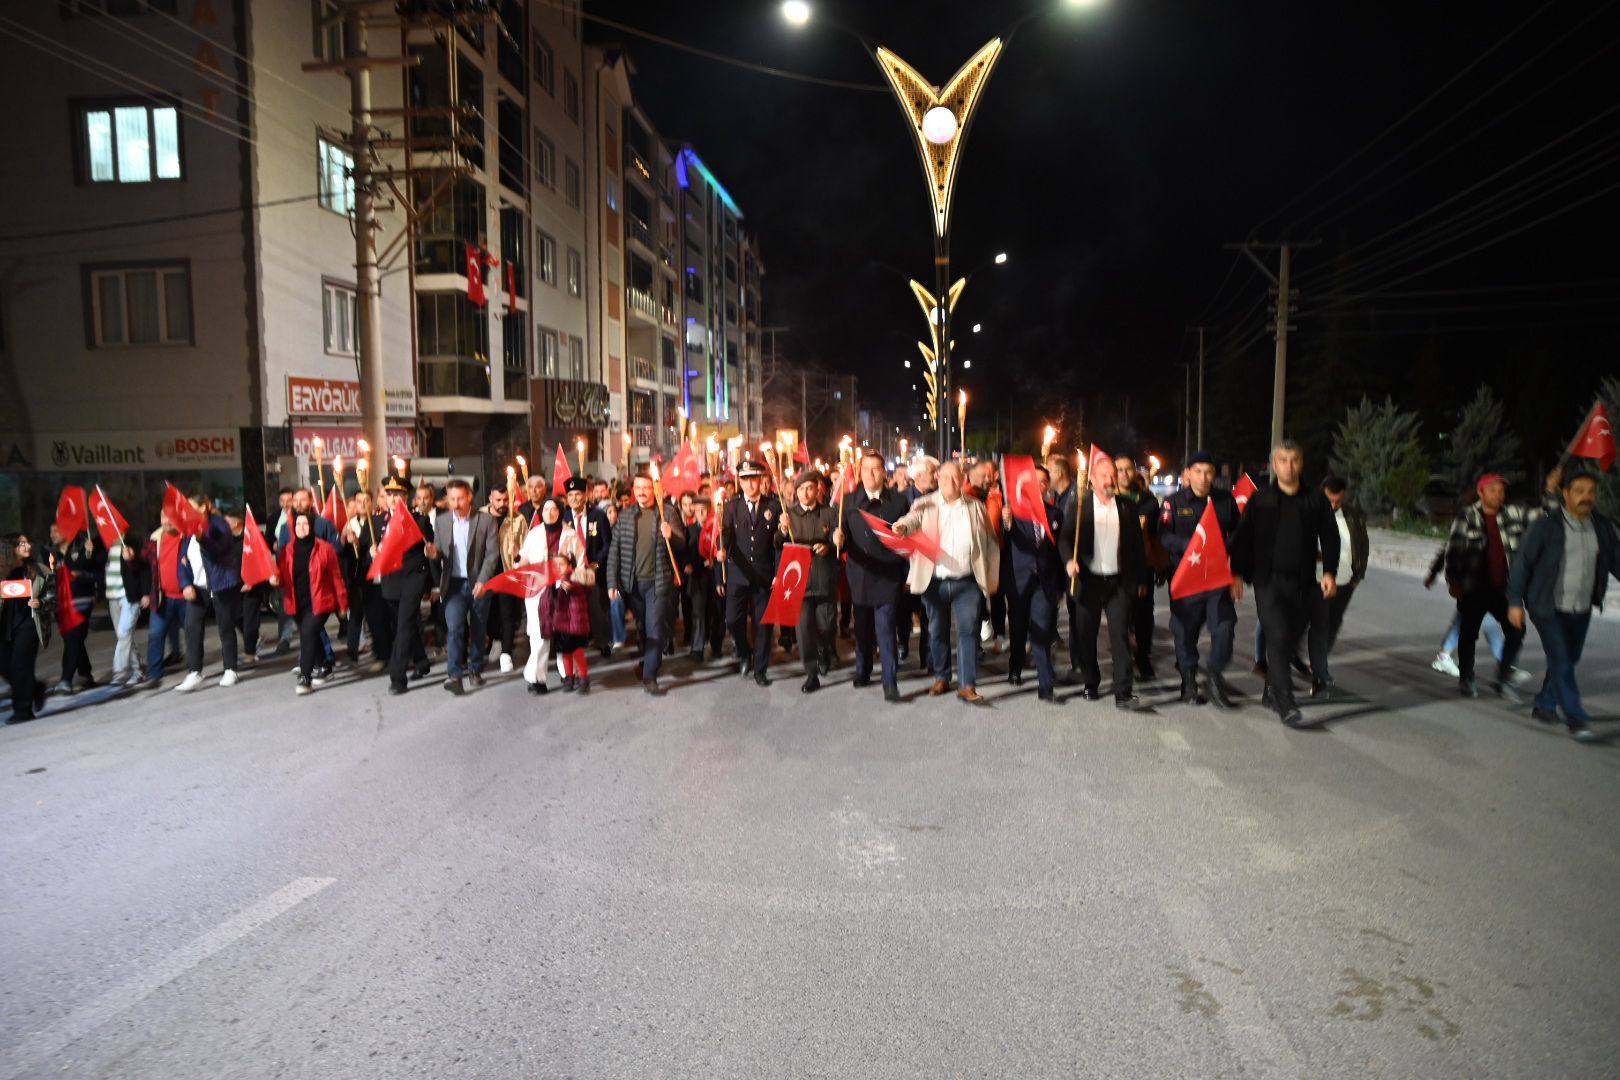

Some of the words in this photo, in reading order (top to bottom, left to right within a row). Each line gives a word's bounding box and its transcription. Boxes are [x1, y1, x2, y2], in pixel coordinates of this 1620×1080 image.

[292, 381, 360, 412] ERYÖRÜK
[71, 443, 146, 465] Vaillant
[174, 436, 235, 454] BOSCH
